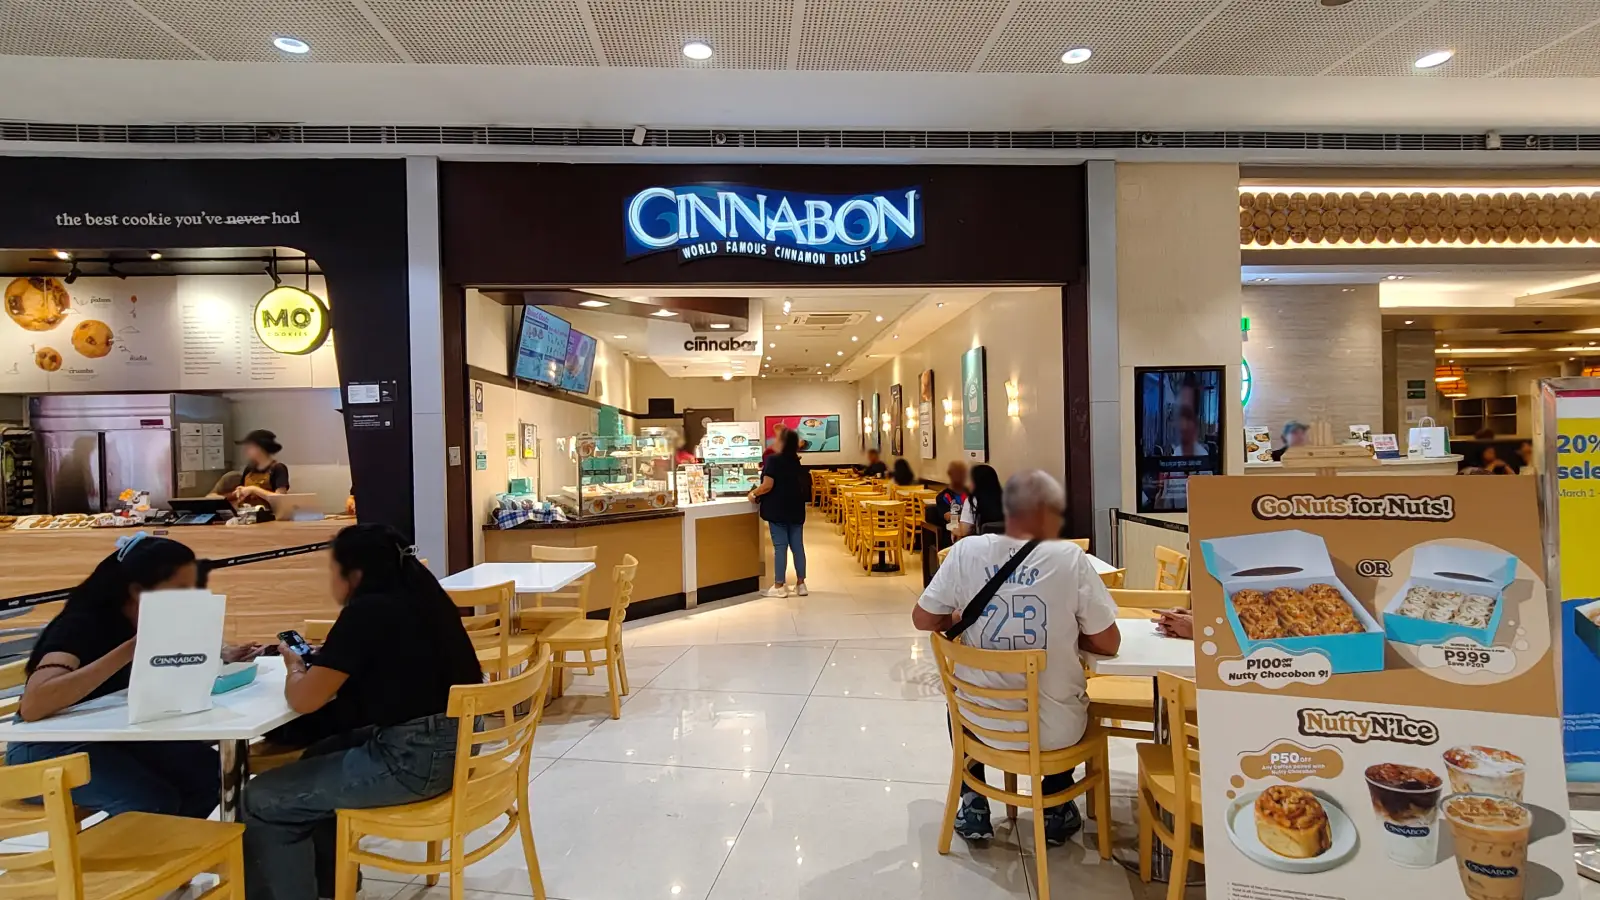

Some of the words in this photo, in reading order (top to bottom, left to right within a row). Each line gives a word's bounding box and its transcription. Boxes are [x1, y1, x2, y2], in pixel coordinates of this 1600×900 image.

[56, 212, 82, 226] the
[84, 212, 119, 226] best
[122, 212, 172, 226] cookie
[175, 211, 222, 228] you've
[225, 214, 269, 225] never
[271, 211, 301, 224] had
[628, 187, 917, 248] CINNABON
[682, 242, 718, 259] WORLD
[726, 242, 767, 256] FAMOUS
[774, 246, 826, 265] CINNAMON
[834, 250, 867, 265] ROLLS
[1557, 434, 1600, 453] 20%
[1259, 497, 1291, 514] Go
[1294, 497, 1347, 515] Nuts
[1350, 496, 1385, 514] for
[1388, 497, 1450, 516] Nuts!
[1359, 560, 1391, 575] OR
[981, 595, 1047, 650] 23
[153, 655, 203, 665] CINNABON
[1228, 672, 1258, 680] Nutty
[1260, 670, 1315, 679] Chocobon
[1318, 670, 1329, 678] 9!
[1385, 823, 1429, 836] CINNABON
[1467, 862, 1516, 875] CINNABON
